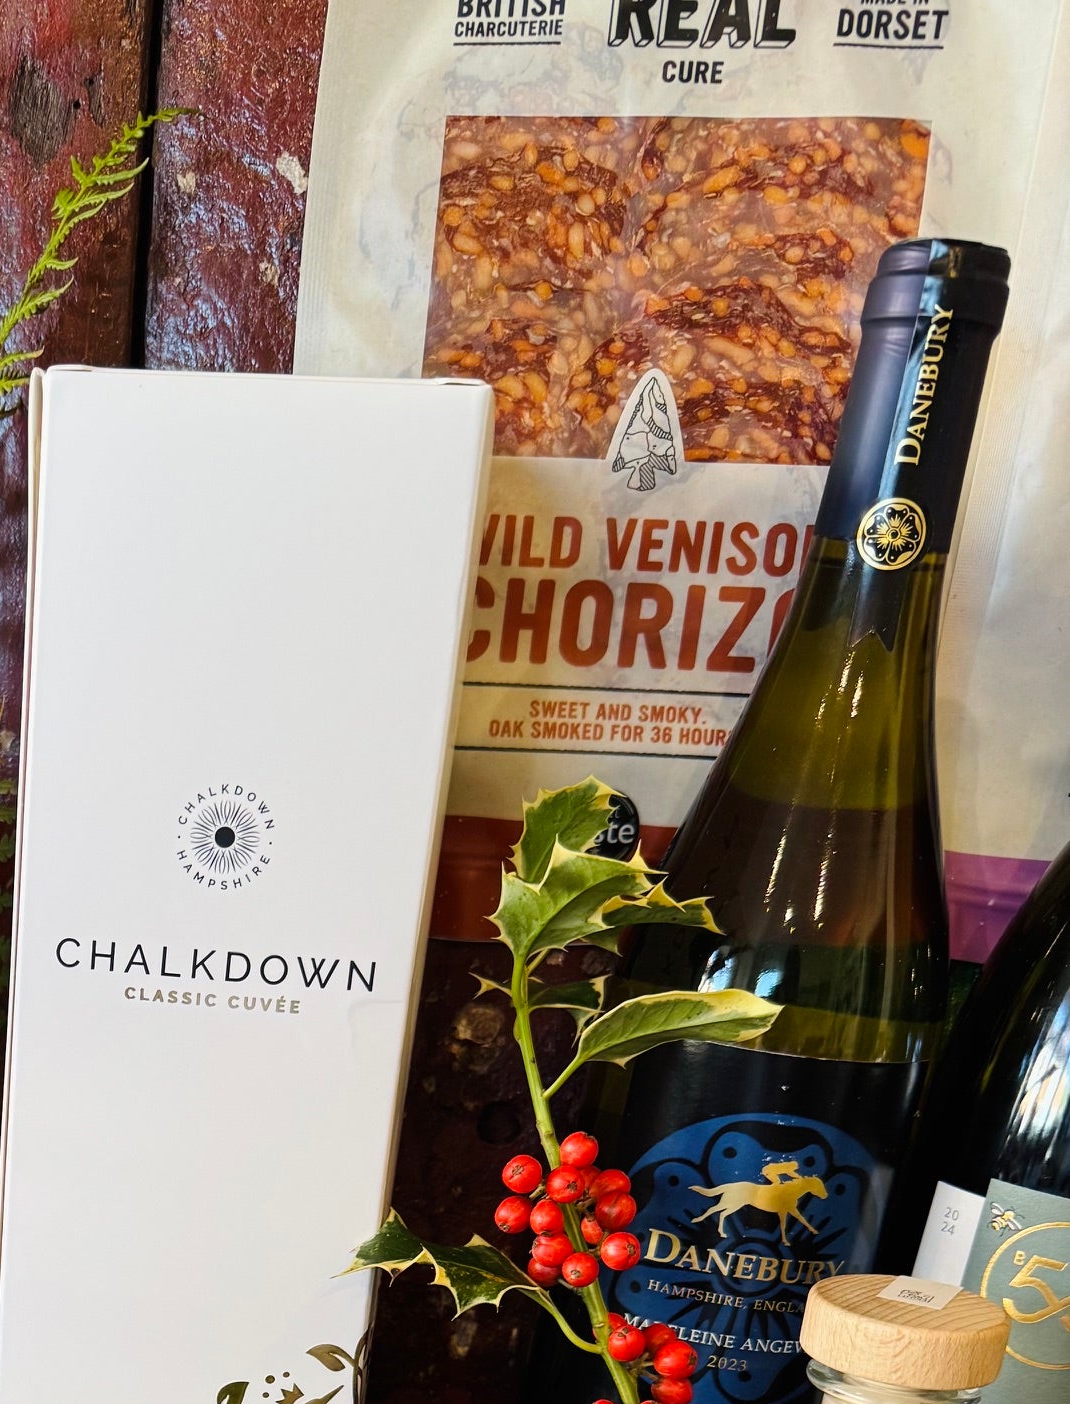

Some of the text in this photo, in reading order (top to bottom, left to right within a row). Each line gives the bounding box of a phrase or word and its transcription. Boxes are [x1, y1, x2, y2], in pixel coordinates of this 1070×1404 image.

[454, 18, 563, 38] CHARCUTERIE
[608, 0, 797, 49] REAL
[836, 9, 949, 41] DORSET
[662, 60, 724, 84] CURE
[894, 305, 954, 466] DANEBURY
[529, 700, 707, 726] SWEET AND SMOKY.
[488, 719, 672, 744] OAK SMOKED FOR 36
[177, 783, 275, 830] CHALKDOWN
[177, 849, 270, 891] HAMPSHIRE
[55, 937, 377, 993] CHALKDOWN
[123, 986, 301, 1014] CLASSIC CUVÉE
[944, 1206, 959, 1221] 20
[940, 1221, 955, 1236] 24
[644, 1228, 845, 1284] DANEBURY
[648, 1280, 747, 1311] HAMPSHIRE,
[706, 1355, 747, 1372] 2023
